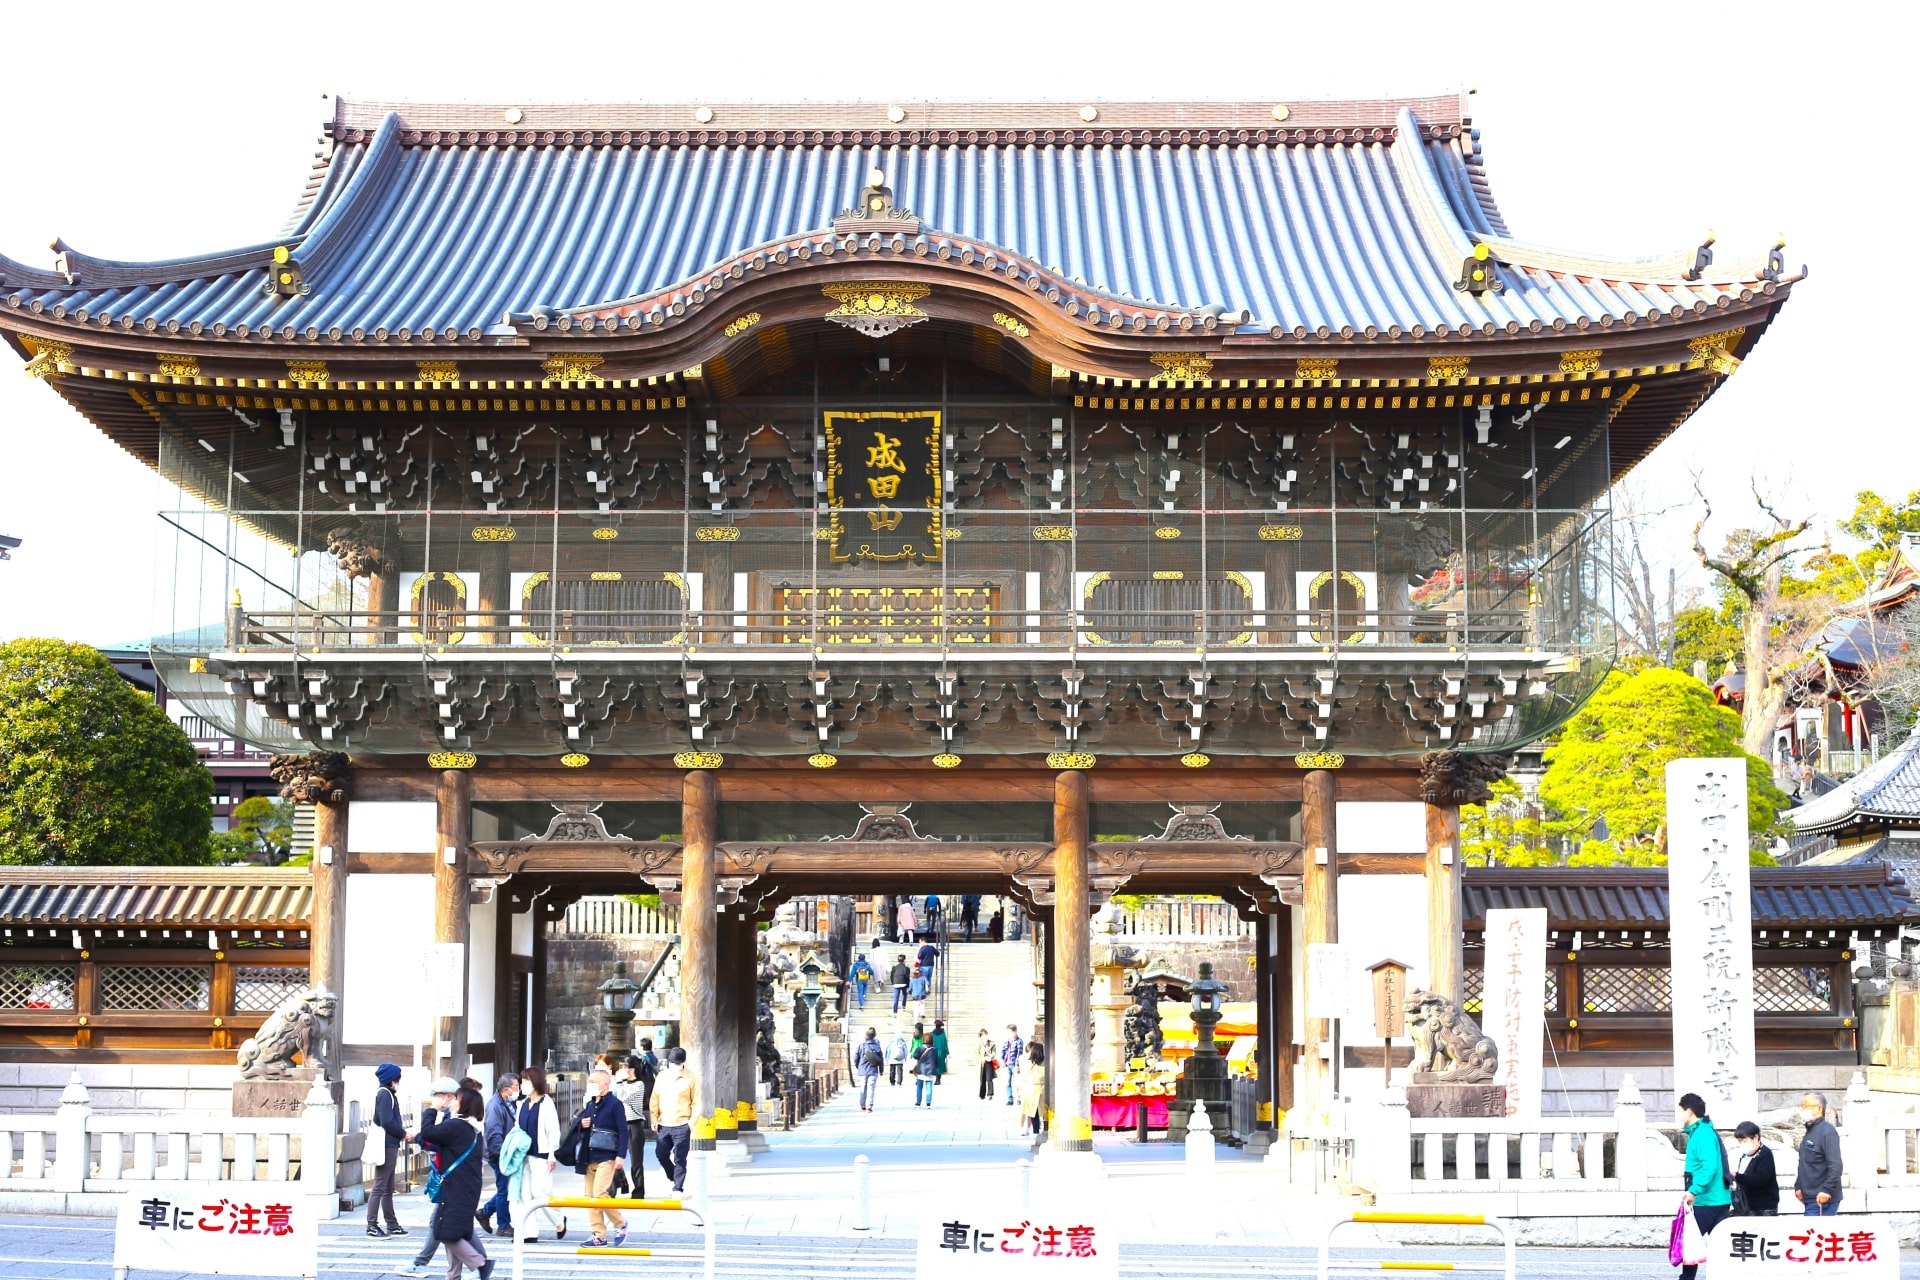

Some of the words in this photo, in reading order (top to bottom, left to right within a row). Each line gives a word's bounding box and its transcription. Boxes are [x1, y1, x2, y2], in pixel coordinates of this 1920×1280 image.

[865, 431, 907, 531] 成田山
[138, 1197, 294, 1237] 車にご注意
[939, 1220, 1098, 1258] 車にご注意
[1729, 1228, 1878, 1263] 車にご注意
